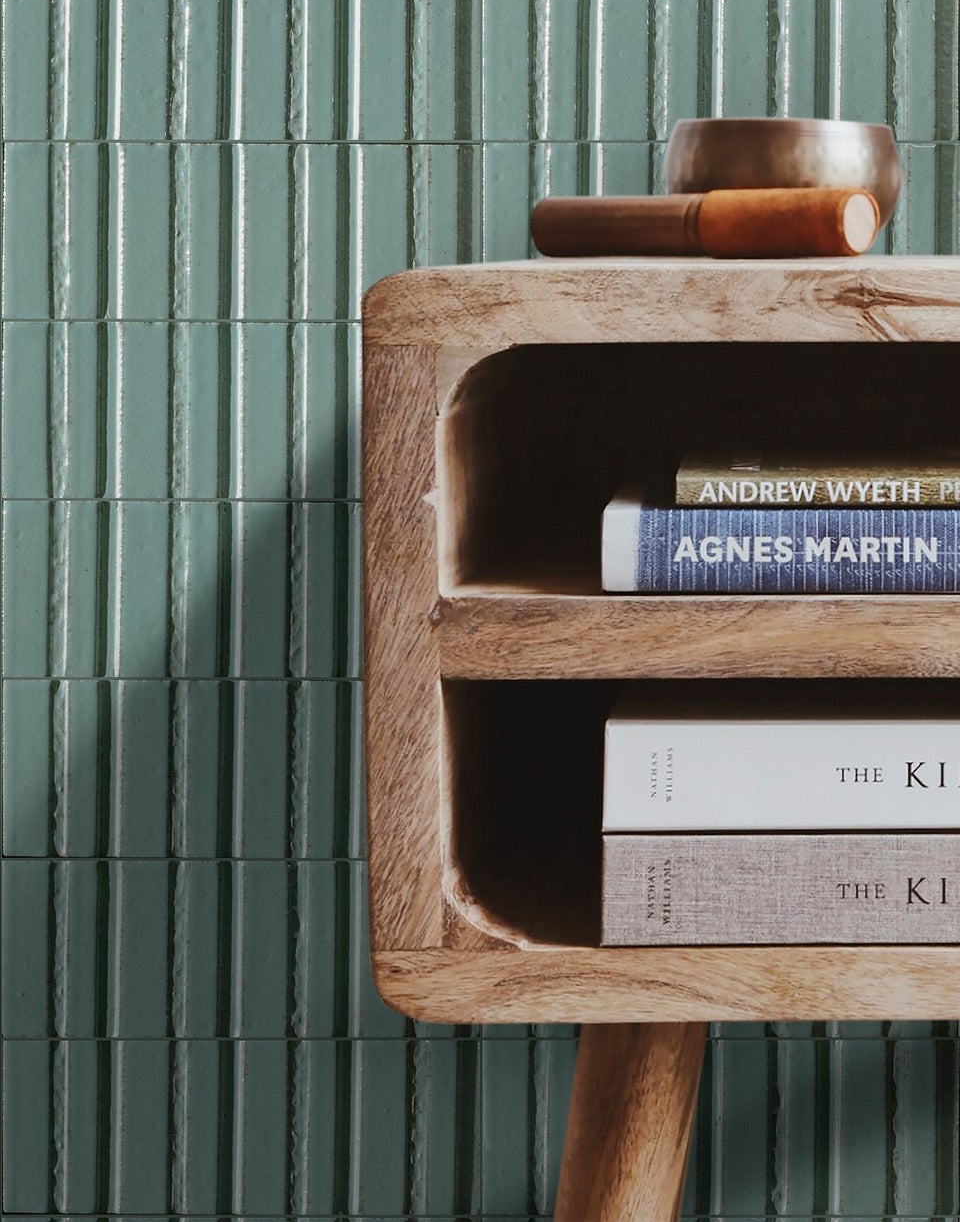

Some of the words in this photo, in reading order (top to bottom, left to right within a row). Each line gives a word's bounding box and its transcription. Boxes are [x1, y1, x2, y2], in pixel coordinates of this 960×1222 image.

[698, 481, 817, 503] ANDREW
[826, 480, 920, 503] WYETH
[674, 536, 793, 563] AGNES
[805, 536, 938, 564] MARTIN
[836, 767, 884, 783] THE
[836, 883, 886, 899] THE
